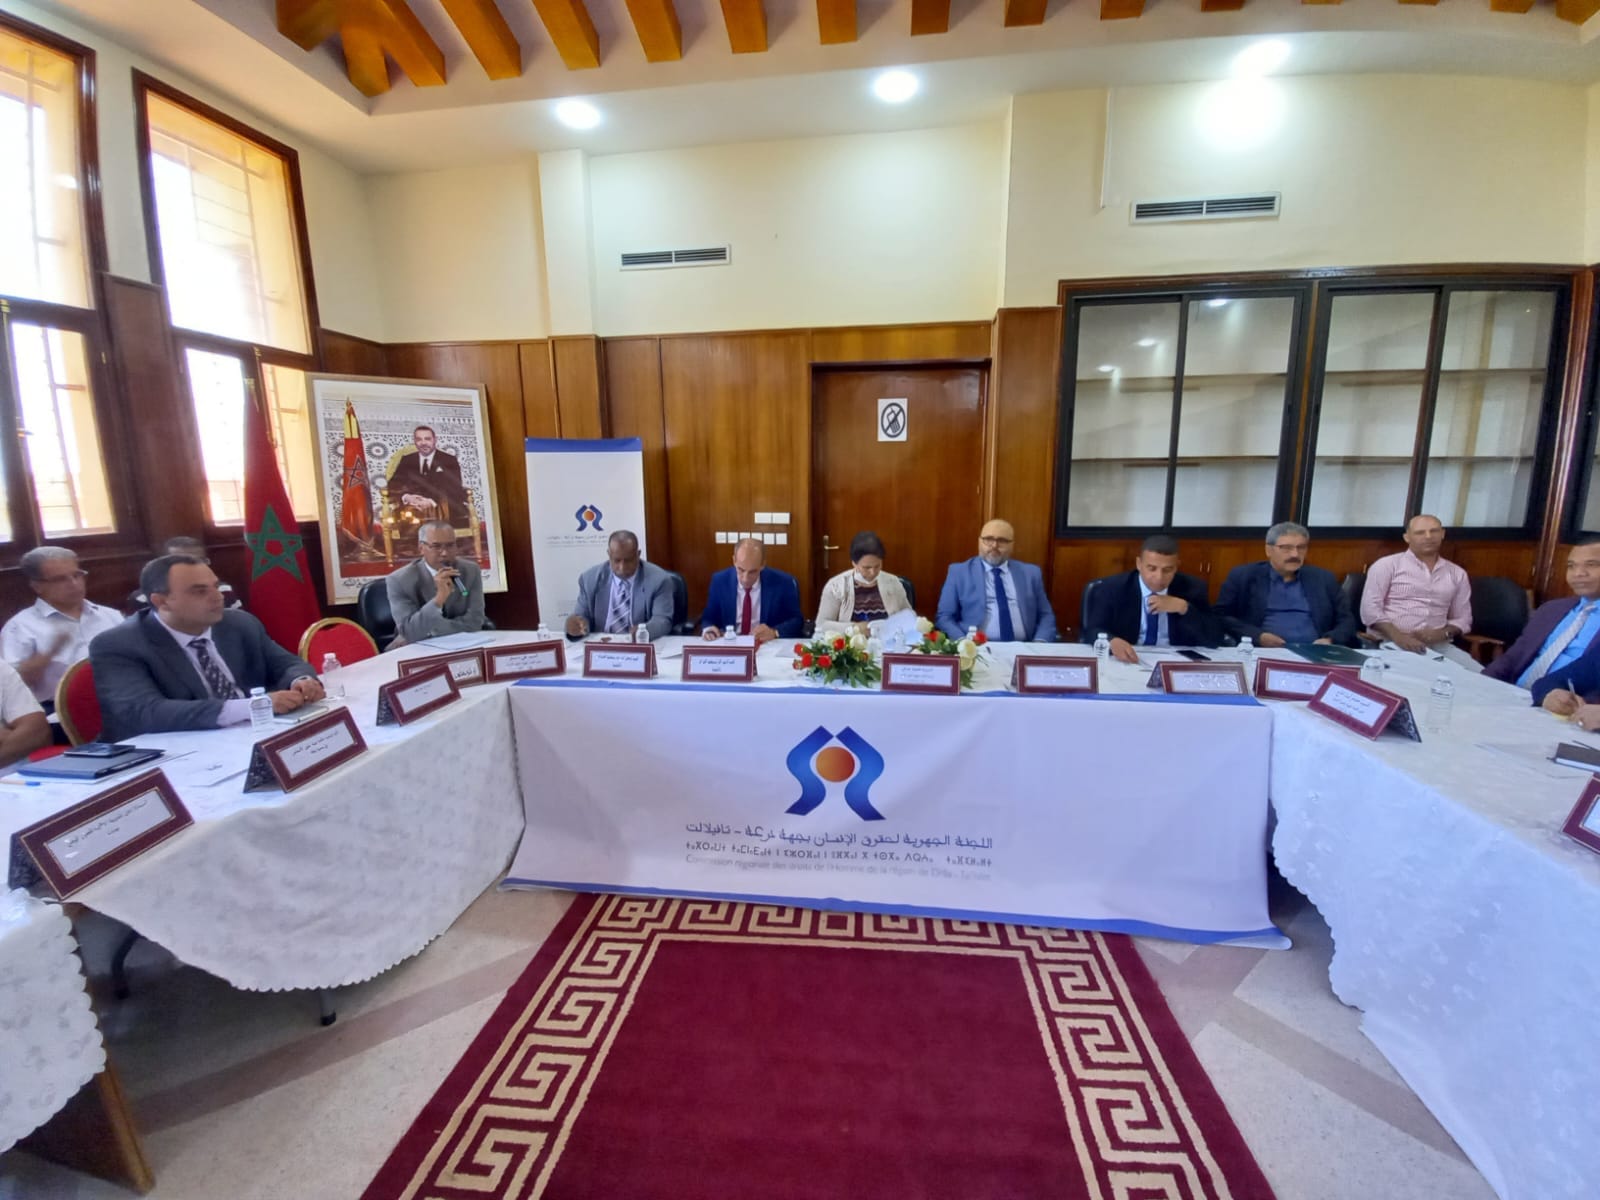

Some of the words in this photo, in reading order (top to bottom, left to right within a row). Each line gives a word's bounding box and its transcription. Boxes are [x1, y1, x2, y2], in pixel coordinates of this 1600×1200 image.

[814, 832, 856, 847] الإنسان
[861, 833, 899, 847] لحقوق
[903, 832, 949, 848] الجهوية
[955, 835, 992, 850] اللجنة
